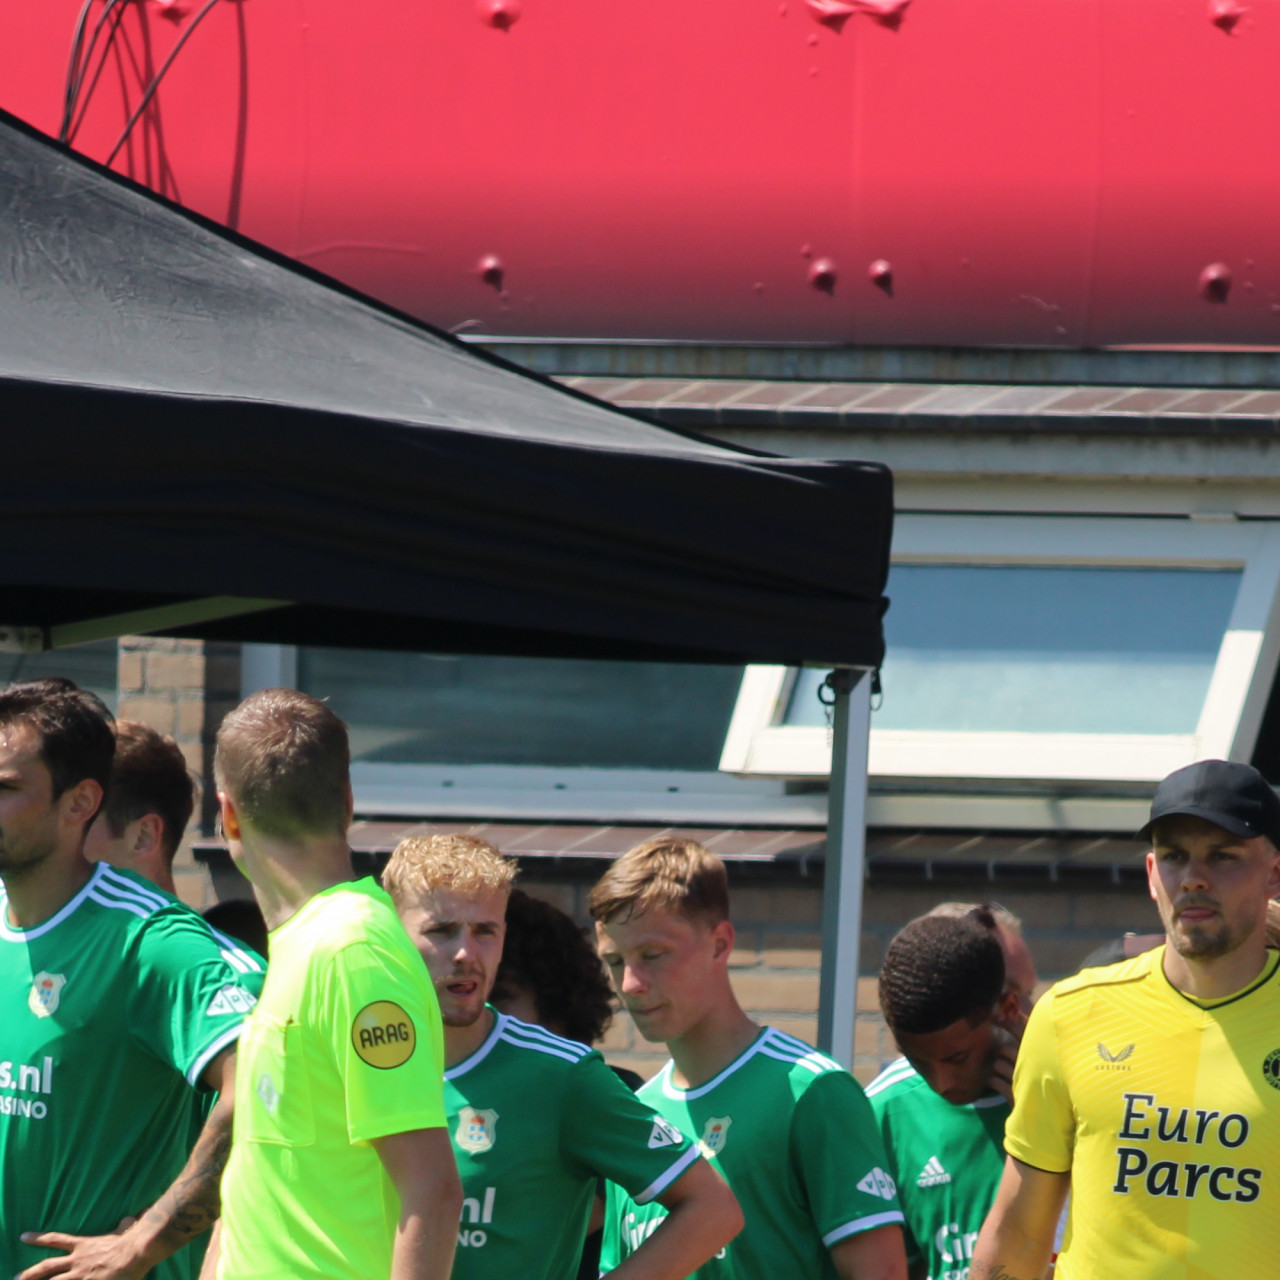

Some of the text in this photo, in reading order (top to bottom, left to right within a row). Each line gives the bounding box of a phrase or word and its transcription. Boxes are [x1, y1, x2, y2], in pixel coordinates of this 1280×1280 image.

[359, 1021, 410, 1050] ARAG
[1118, 1092, 1250, 1149] Euro
[1112, 1146, 1263, 1203] Parcs
